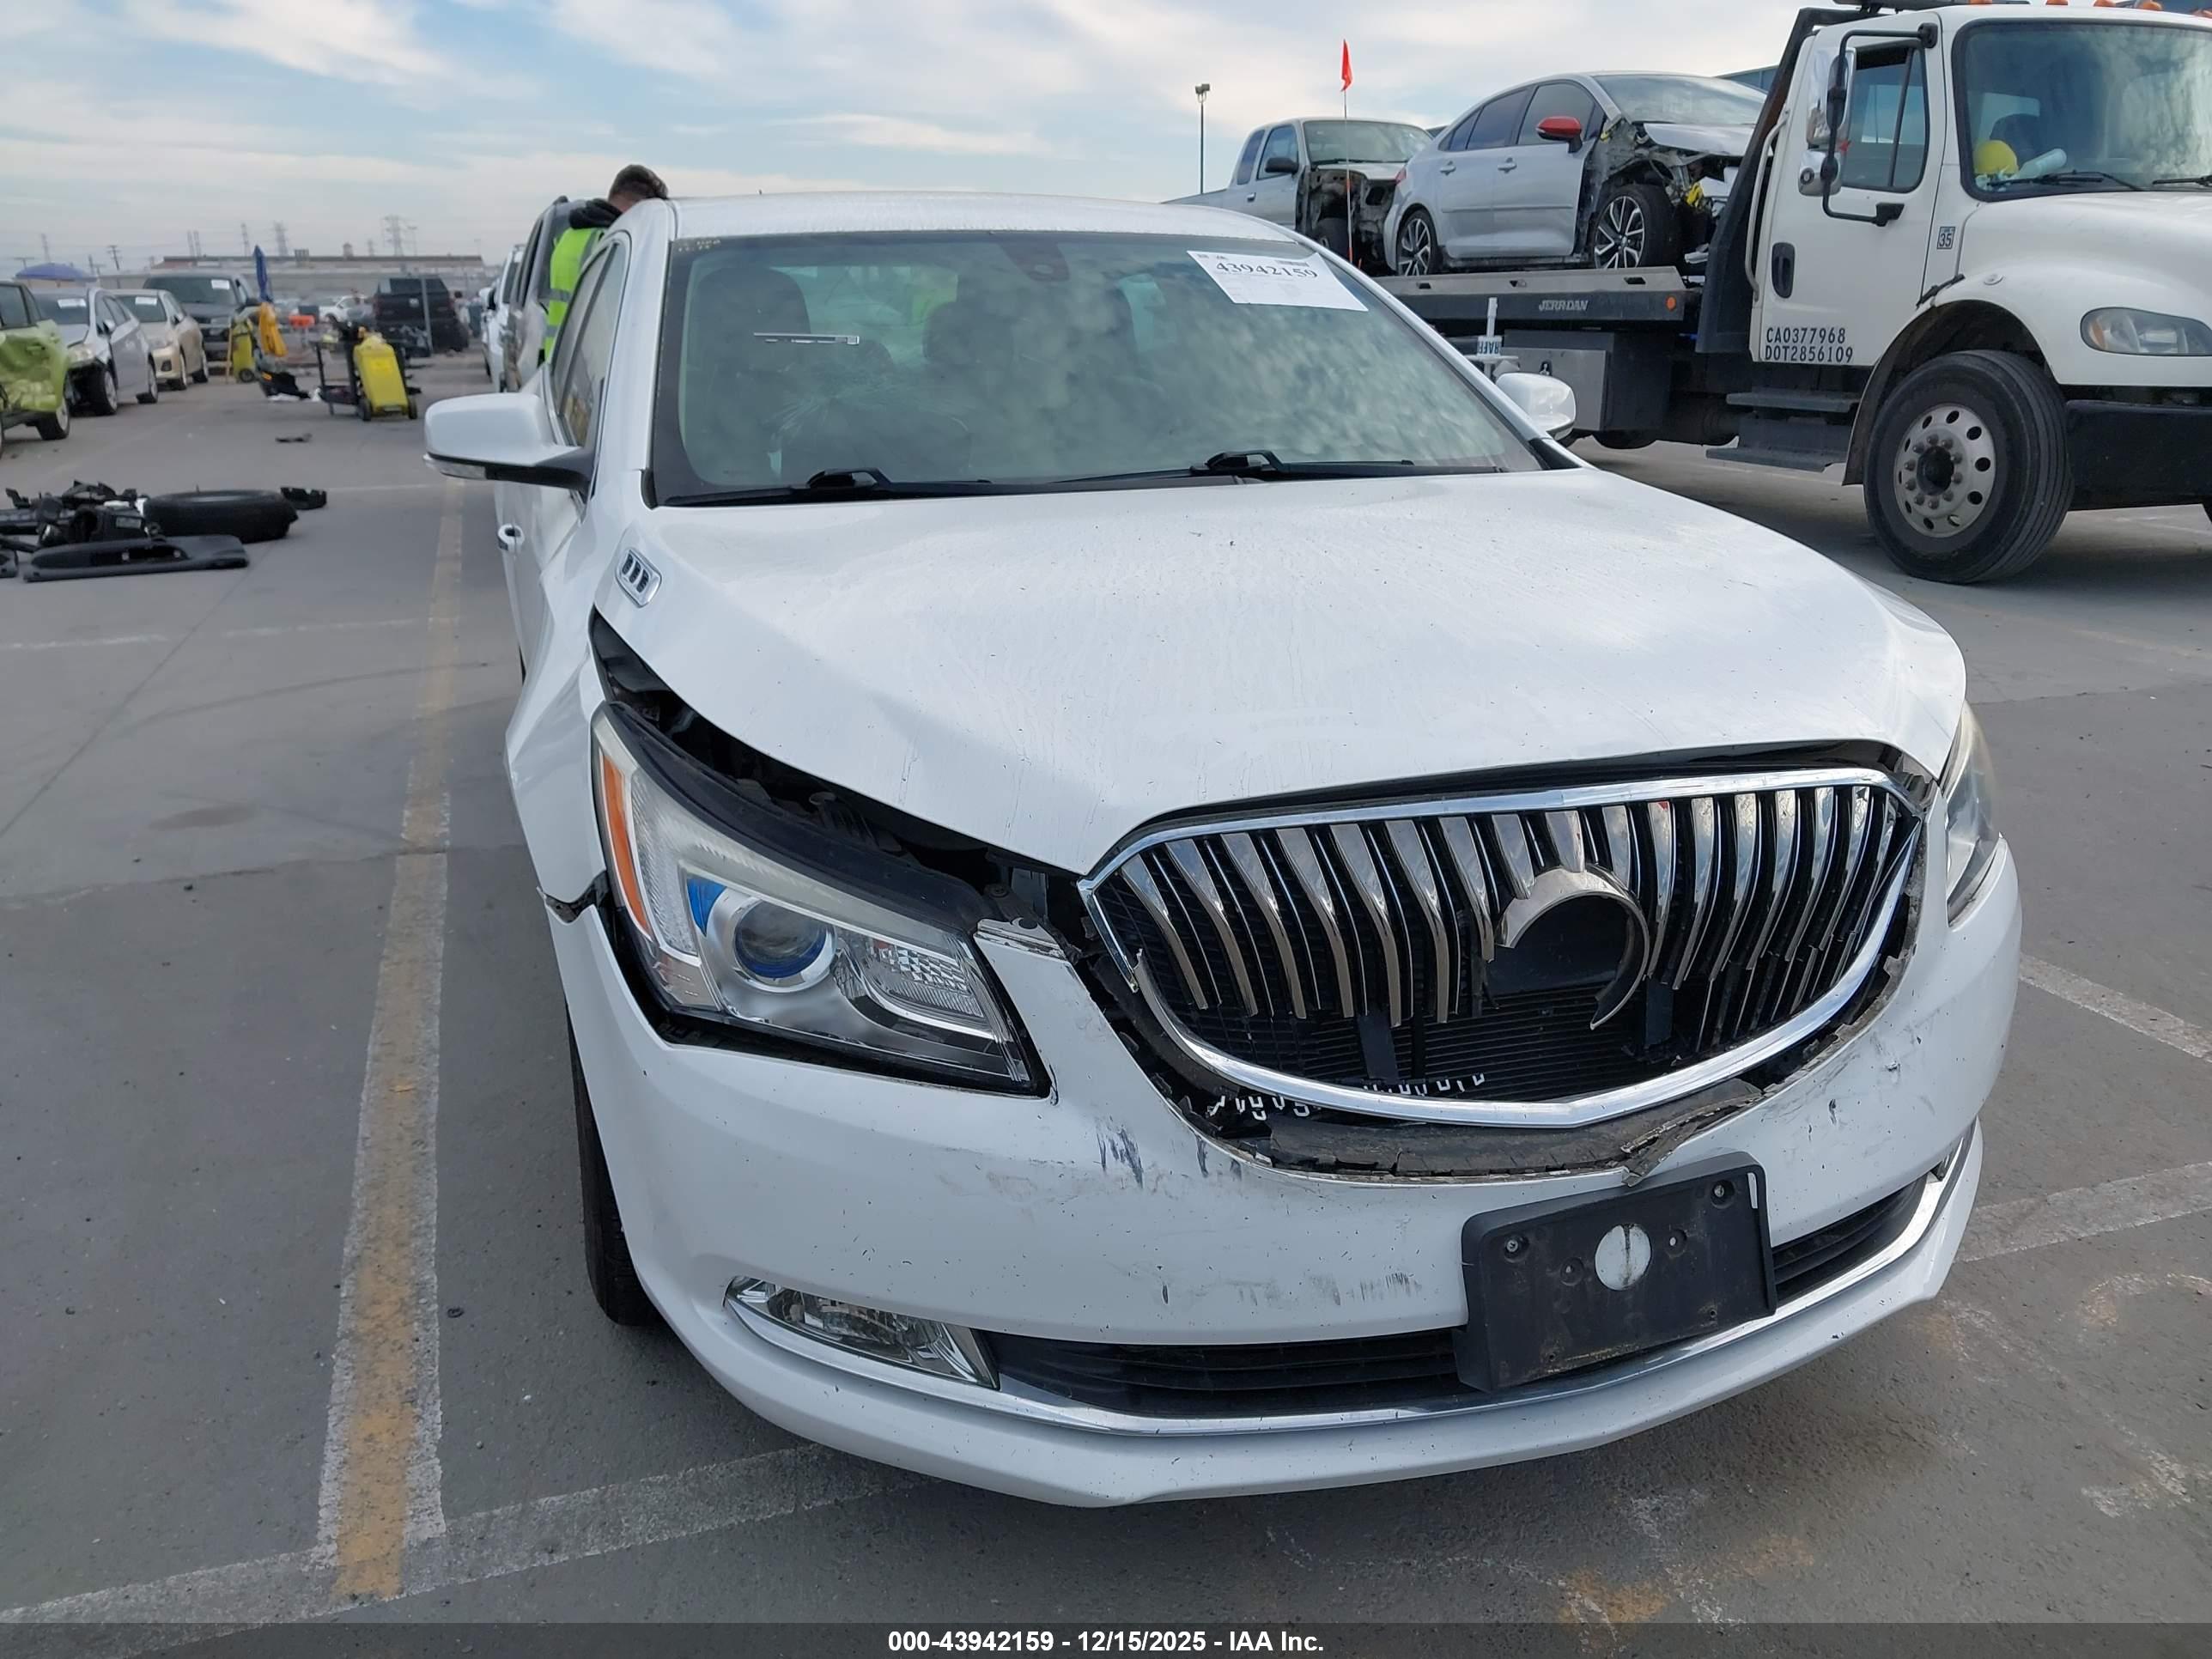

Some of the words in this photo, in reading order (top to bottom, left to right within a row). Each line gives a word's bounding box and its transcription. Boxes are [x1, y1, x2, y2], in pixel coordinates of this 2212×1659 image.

[1939, 233, 1952, 247] 35
[1215, 262, 1318, 278] 43942159
[1766, 327, 1845, 344] CA0377968
[1765, 345, 1853, 363] DOT2856109
